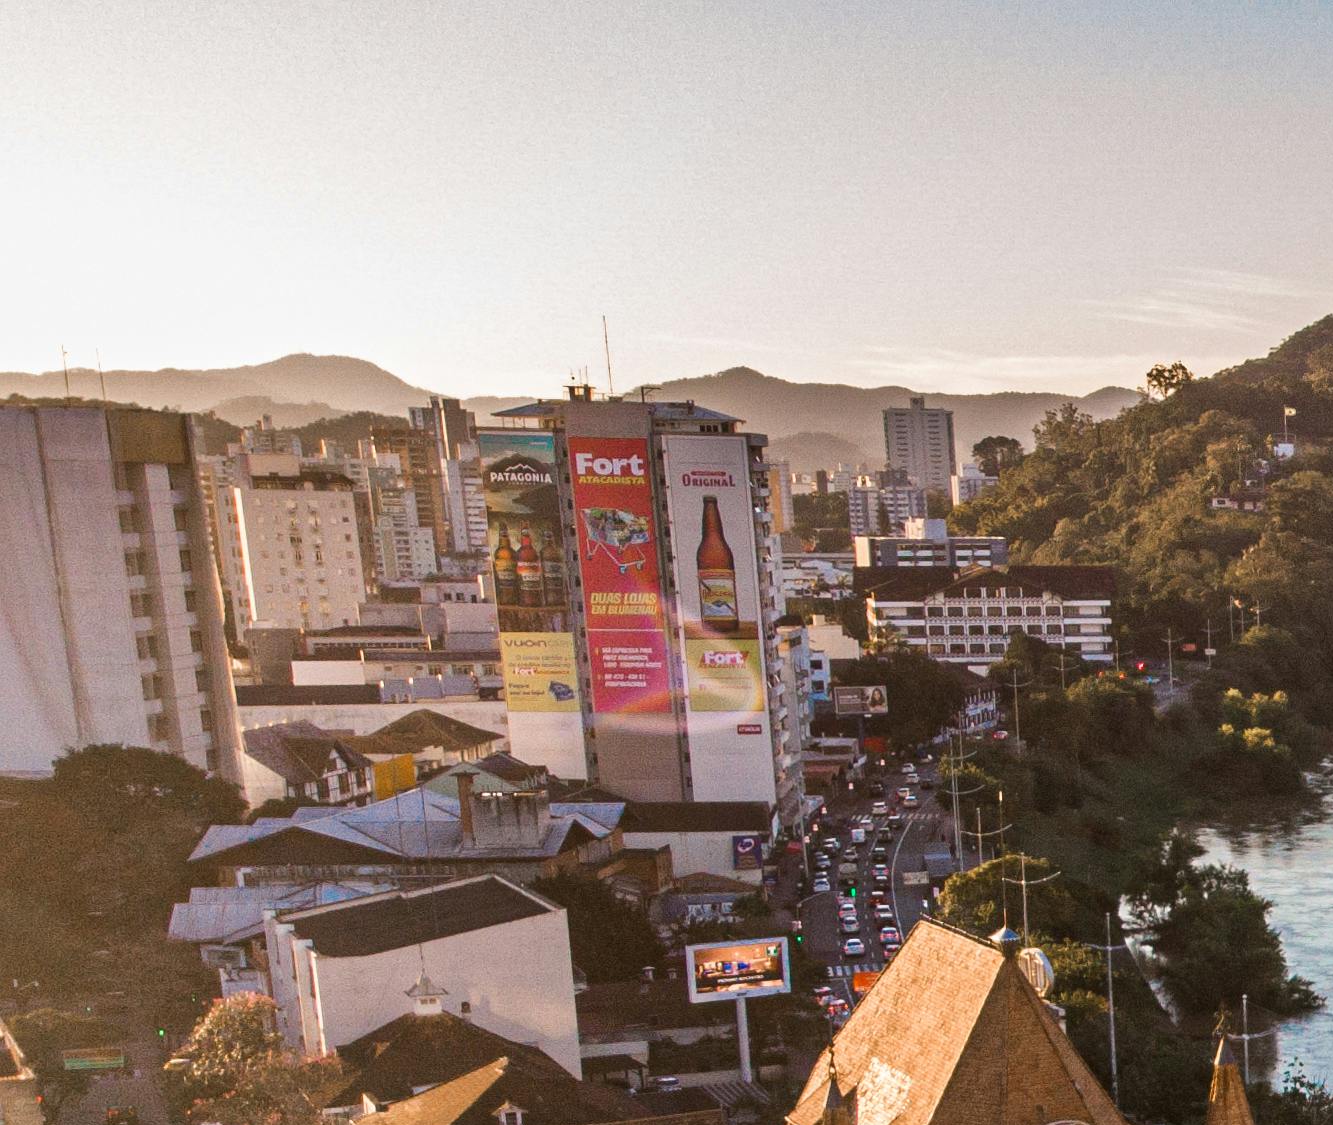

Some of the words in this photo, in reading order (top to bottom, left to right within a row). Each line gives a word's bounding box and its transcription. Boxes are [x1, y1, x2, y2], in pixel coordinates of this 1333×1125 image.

[576, 453, 644, 476] Fort
[490, 471, 553, 483] PATAGONIA
[579, 476, 645, 485] ATACADISTA
[682, 474, 736, 487] ORIGINAL
[591, 592, 621, 604] DUAS
[624, 592, 657, 604] LOJAS
[591, 604, 606, 615] EM
[607, 604, 657, 615] BLUMENAU
[704, 650, 744, 664] Fort
